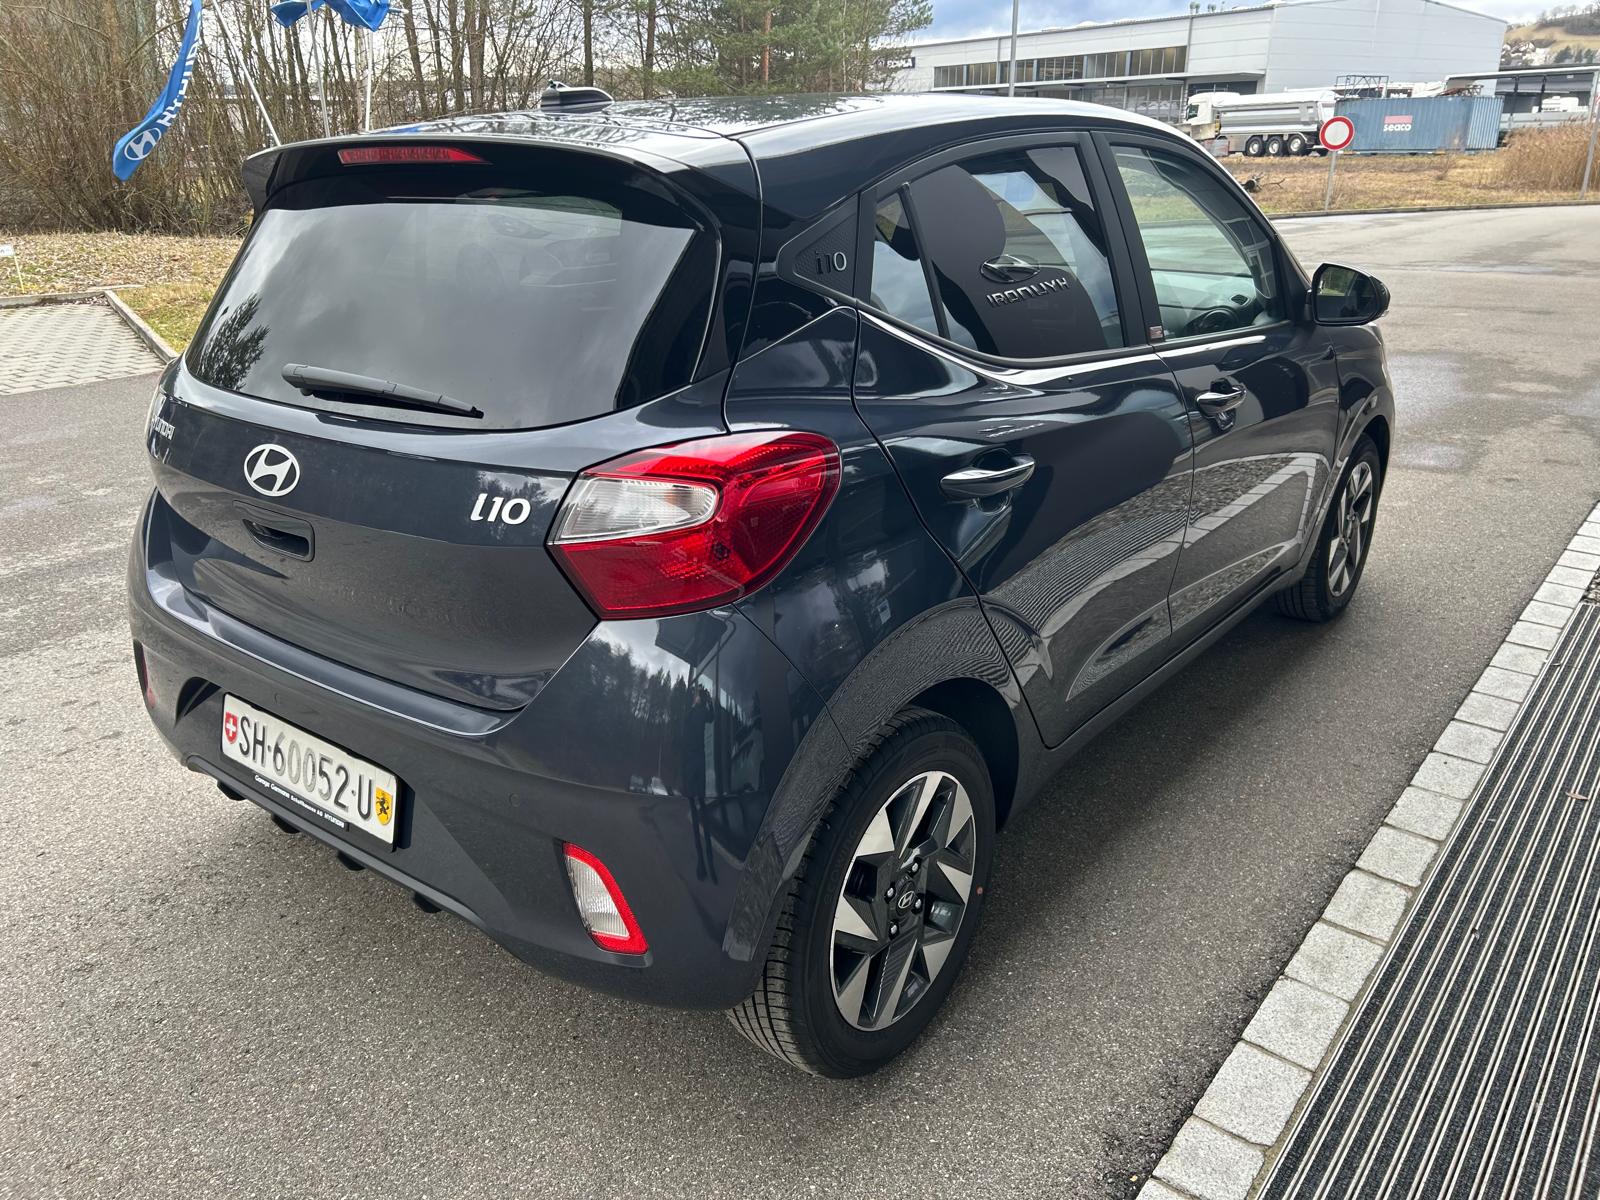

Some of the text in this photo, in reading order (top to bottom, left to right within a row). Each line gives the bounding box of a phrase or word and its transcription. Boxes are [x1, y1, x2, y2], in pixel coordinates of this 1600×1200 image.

[1383, 123, 1412, 132] seaco
[815, 250, 847, 275] i10
[470, 493, 531, 525] i10
